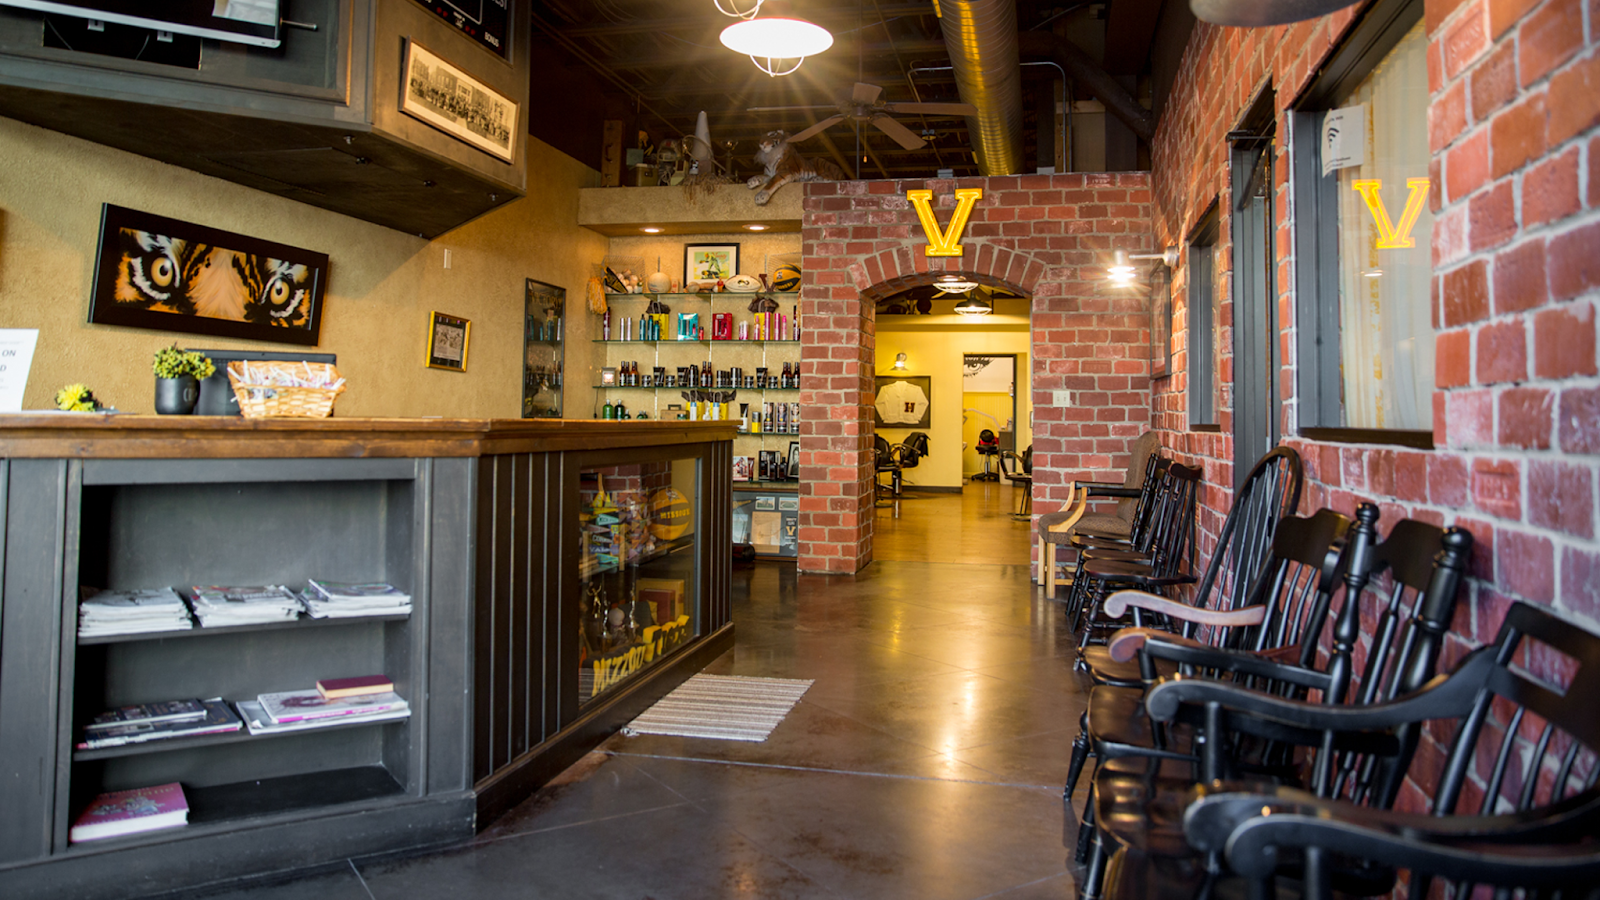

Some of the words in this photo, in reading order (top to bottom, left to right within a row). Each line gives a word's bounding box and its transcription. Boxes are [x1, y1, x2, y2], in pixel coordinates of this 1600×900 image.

[484, 31, 500, 48] BONUS
[906, 188, 983, 257] V
[1352, 177, 1430, 249] V
[904, 402, 916, 413] H
